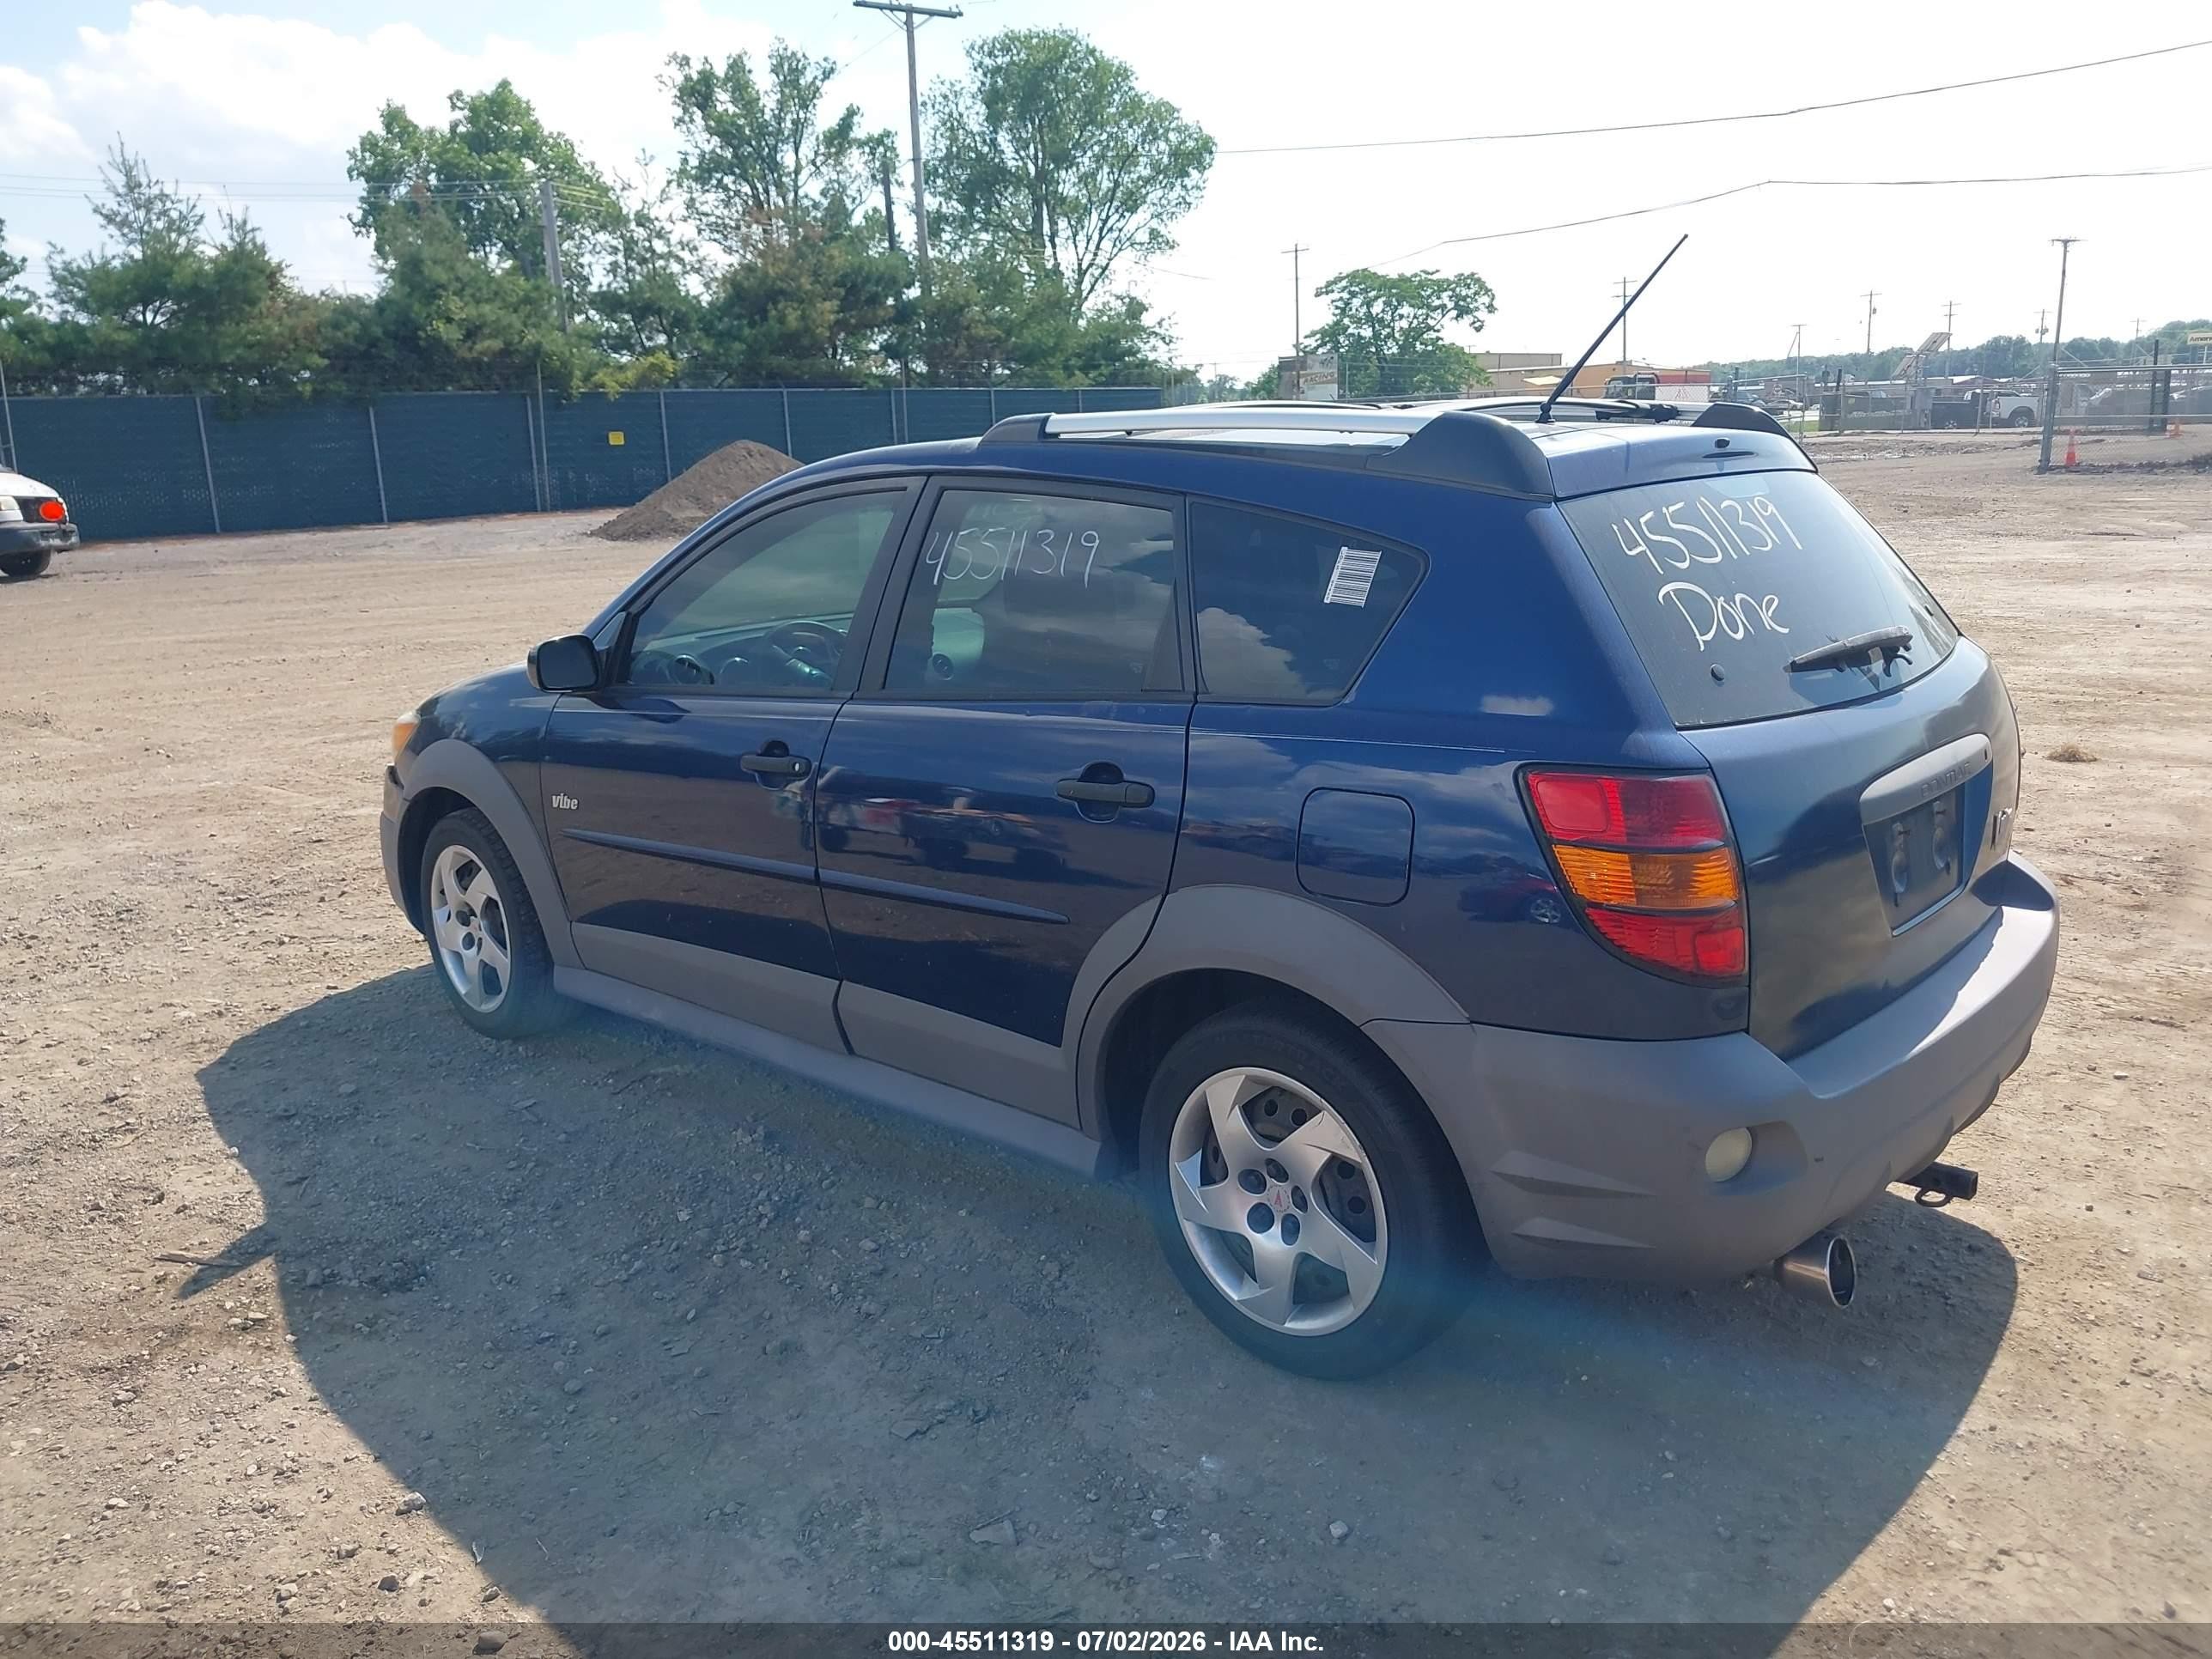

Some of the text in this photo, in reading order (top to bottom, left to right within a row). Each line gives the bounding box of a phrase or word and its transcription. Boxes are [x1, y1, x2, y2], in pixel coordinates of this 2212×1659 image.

[926, 526, 1100, 589] 45511319
[1611, 495, 1803, 574] 45511319
[1657, 581, 1790, 653] Done
